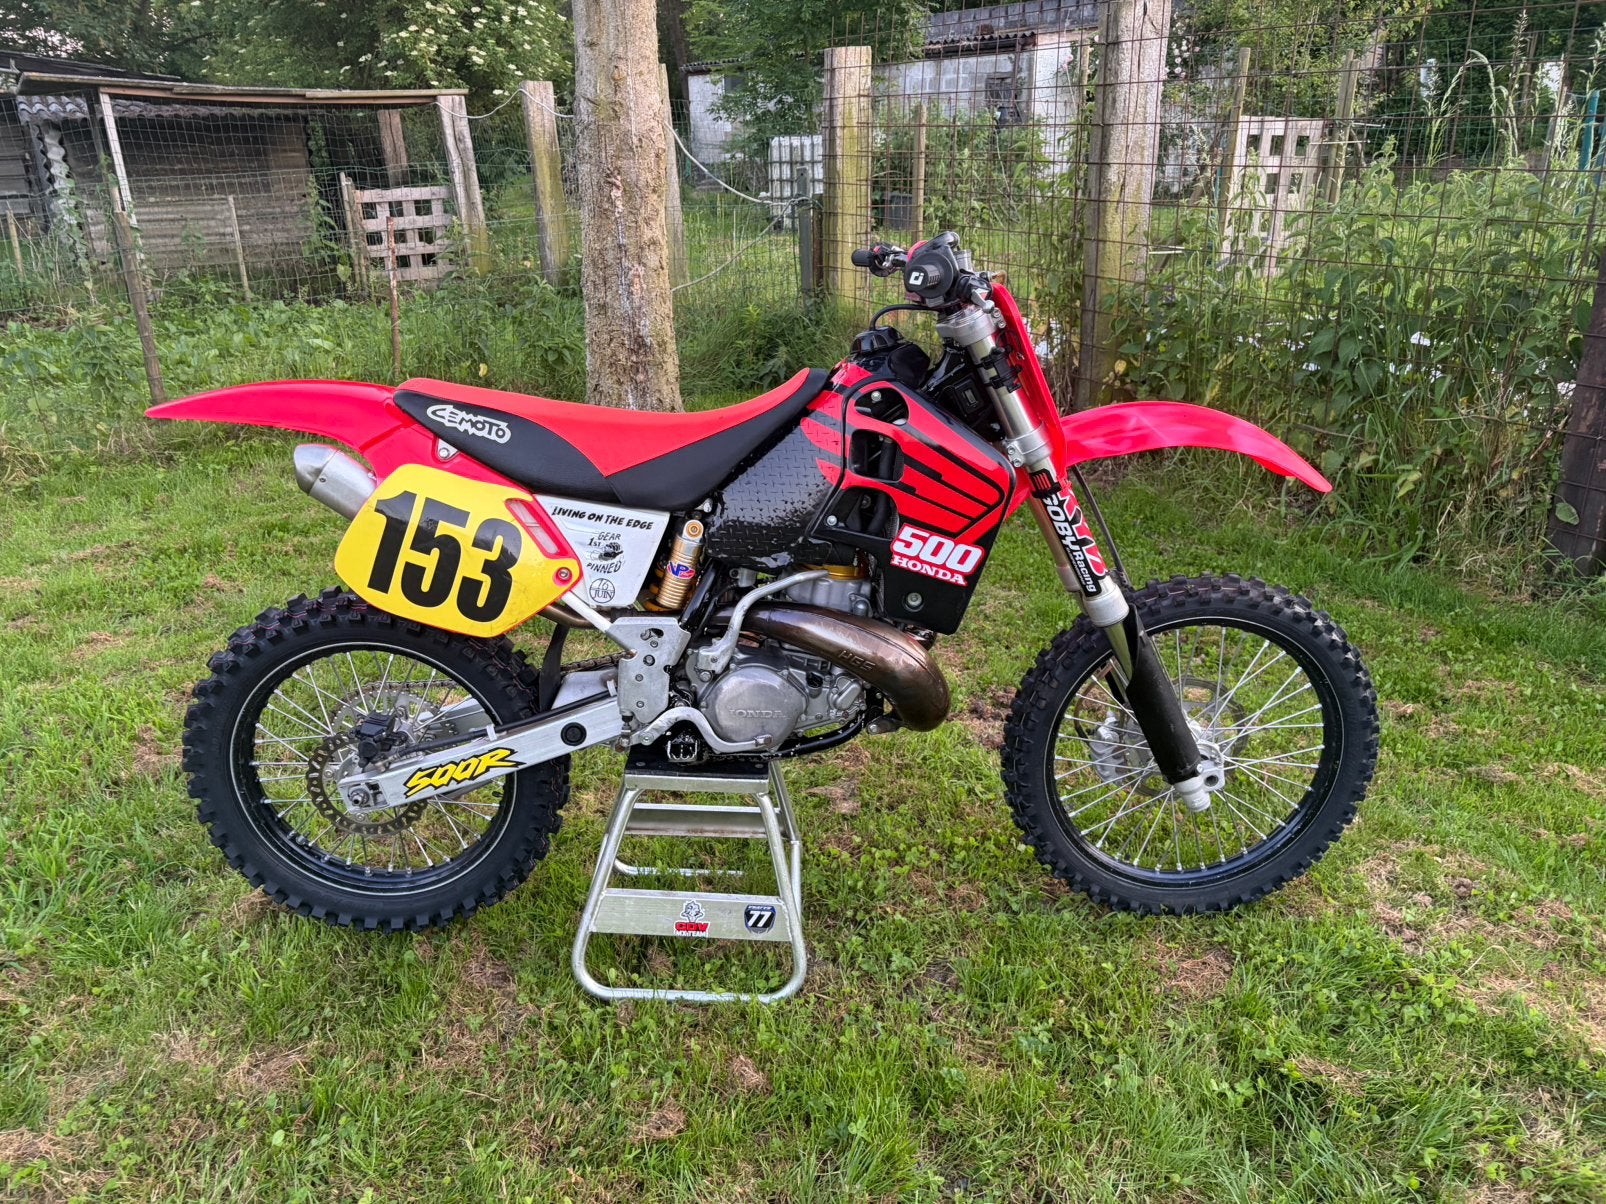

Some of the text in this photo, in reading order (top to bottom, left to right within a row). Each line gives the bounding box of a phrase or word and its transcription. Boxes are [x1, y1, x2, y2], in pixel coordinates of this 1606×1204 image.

[552, 506, 654, 530] LIVING ON THE EDGE
[598, 531, 621, 541] GEAR
[367, 490, 522, 622] 153
[892, 525, 983, 573] 500
[586, 560, 622, 574] PINNED
[669, 561, 690, 577] VP
[891, 554, 967, 586] HONDA
[1073, 552, 1097, 593] Racing
[593, 589, 613, 599] JUIN
[598, 579, 609, 590] 16
[404, 748, 523, 798] 500R
[748, 910, 772, 927] 77
